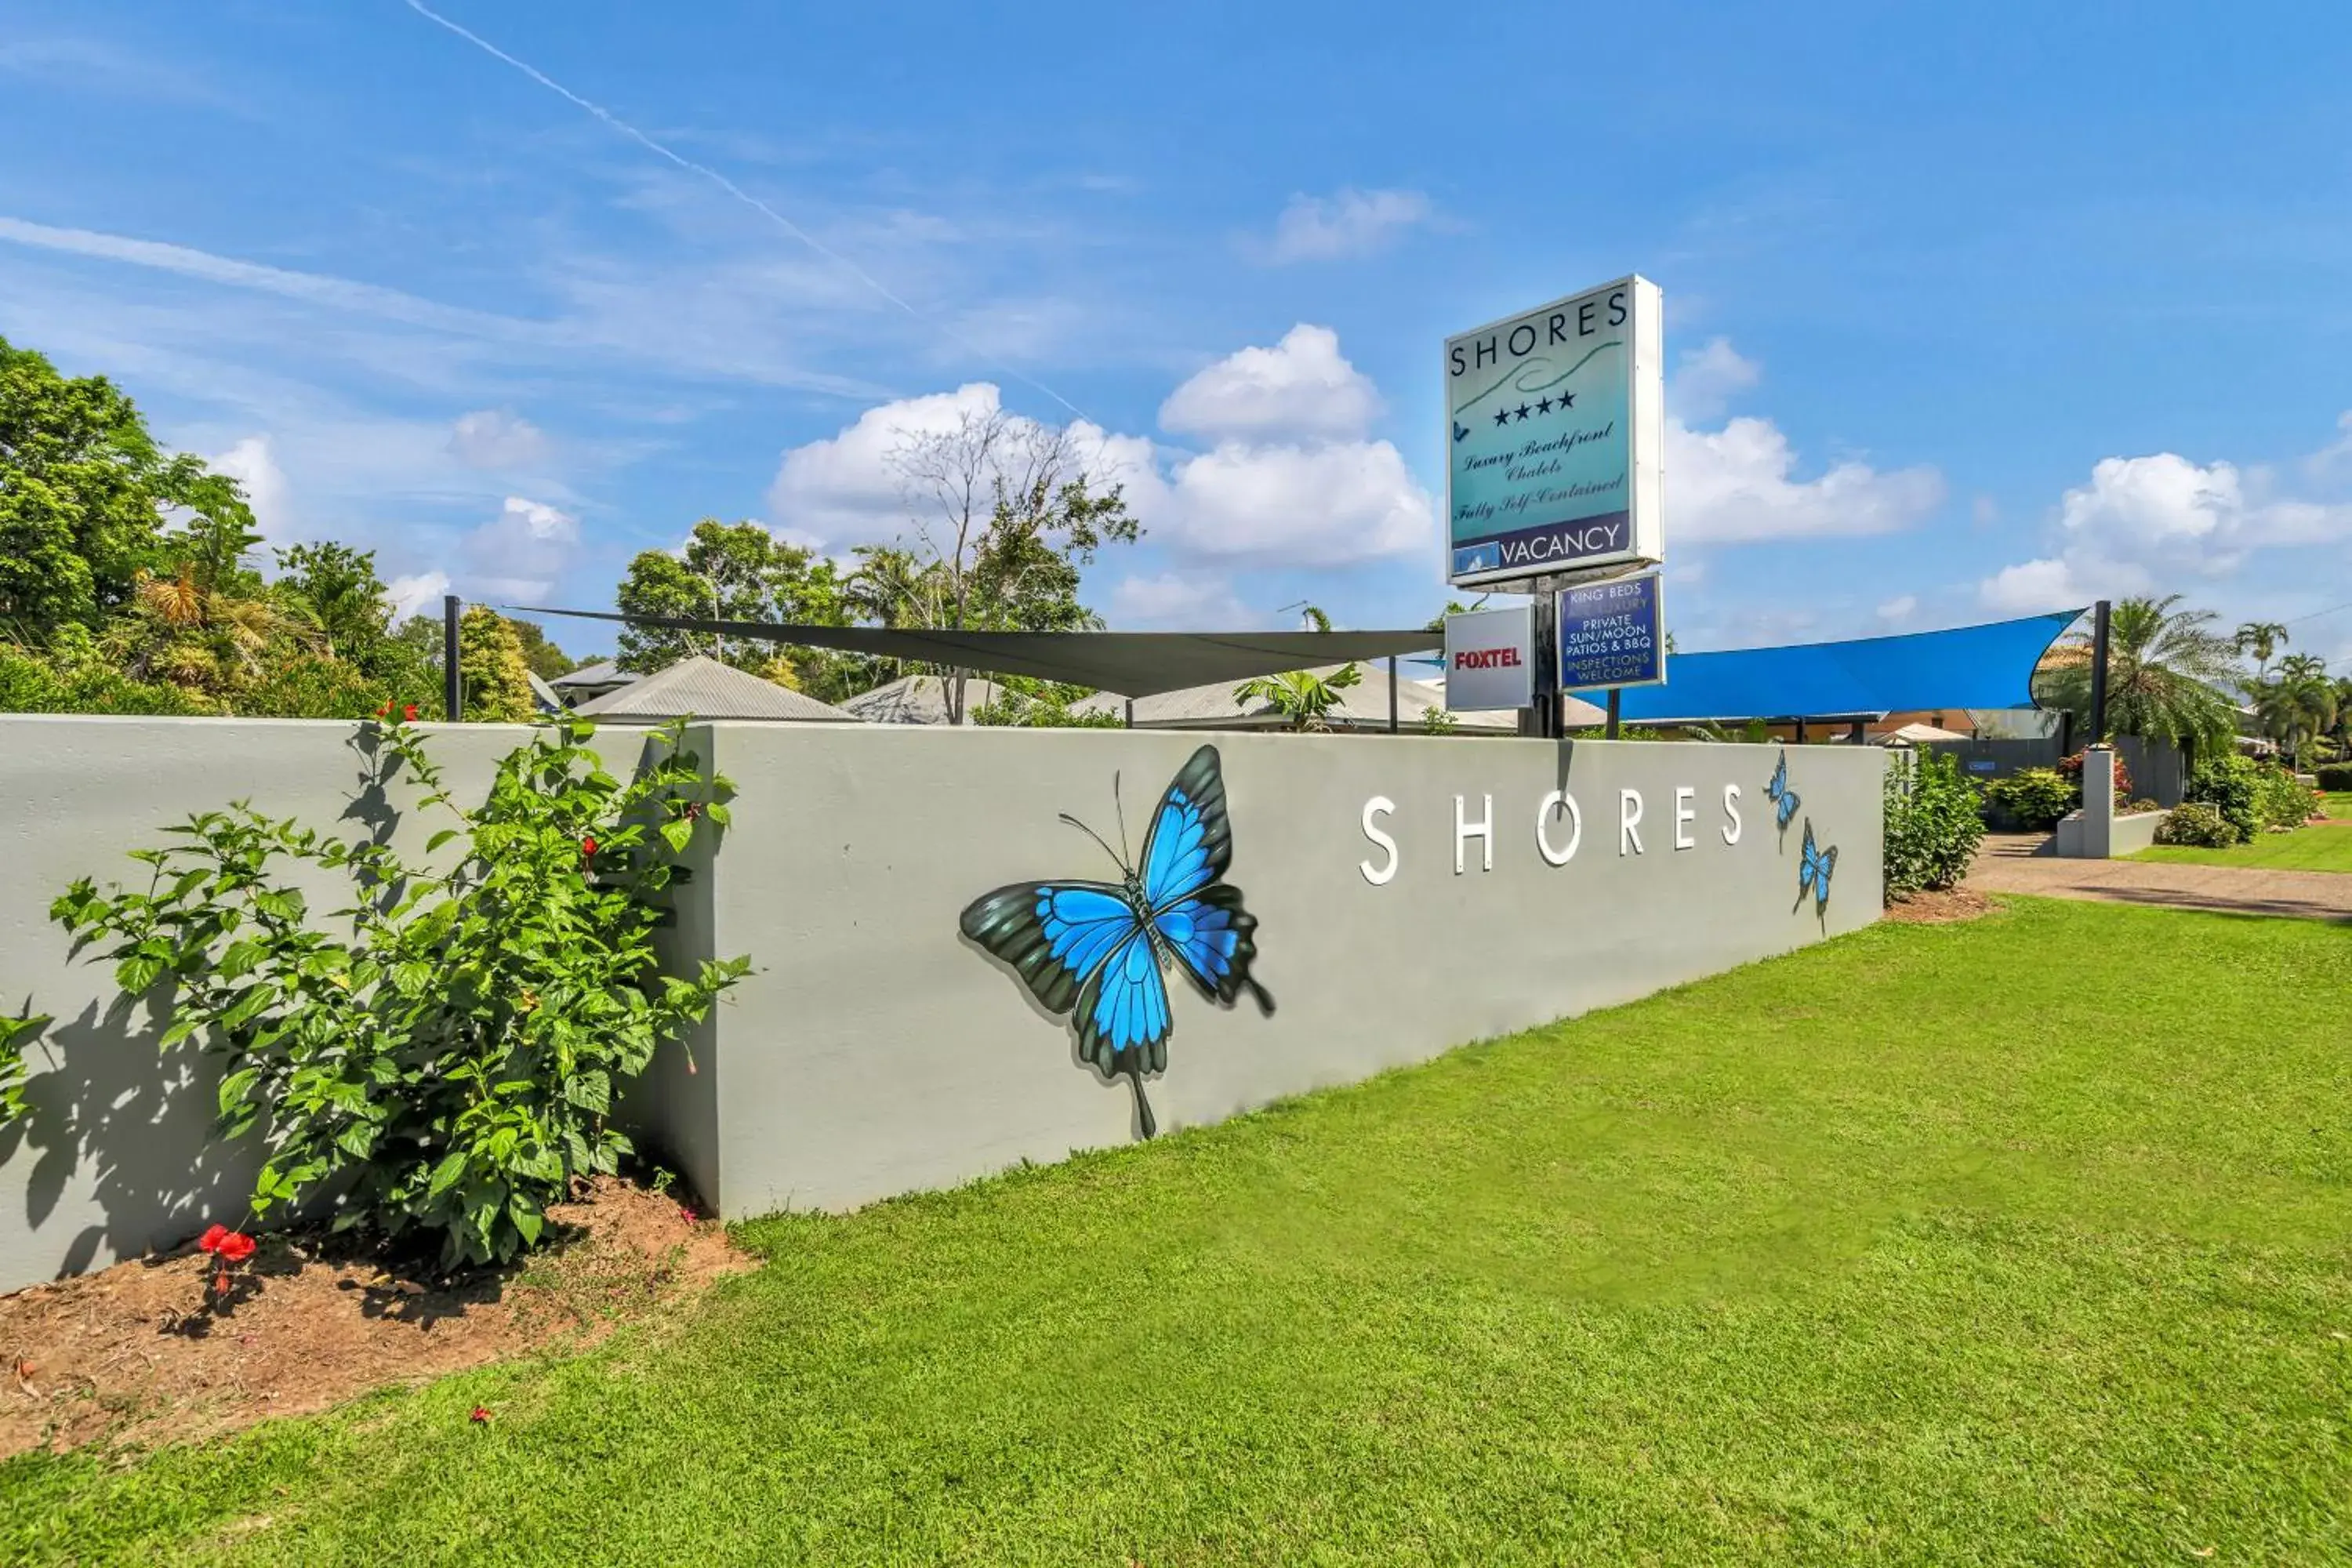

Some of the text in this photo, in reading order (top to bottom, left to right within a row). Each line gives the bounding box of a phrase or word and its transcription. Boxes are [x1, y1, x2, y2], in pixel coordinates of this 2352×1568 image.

[1451, 292, 1627, 376] SHORES
[1464, 420, 1613, 471] Luxury Beachfront
[1505, 458, 1563, 481] Chalets
[1454, 473, 1624, 521] Fully Self Contained
[1501, 523, 1621, 564] VACANCY
[1570, 583, 1642, 604] KING BEDS
[1583, 614, 1632, 630] PRIVATE
[1570, 624, 1646, 644] SUN/MOON
[1566, 636, 1650, 656] PATIOS & BBQ
[1454, 647, 1522, 670] FOXTEL
[1567, 652, 1650, 671] INSPECTIONS
[1577, 666, 1641, 681] WELCOME
[1359, 784, 1741, 886] SHORES
